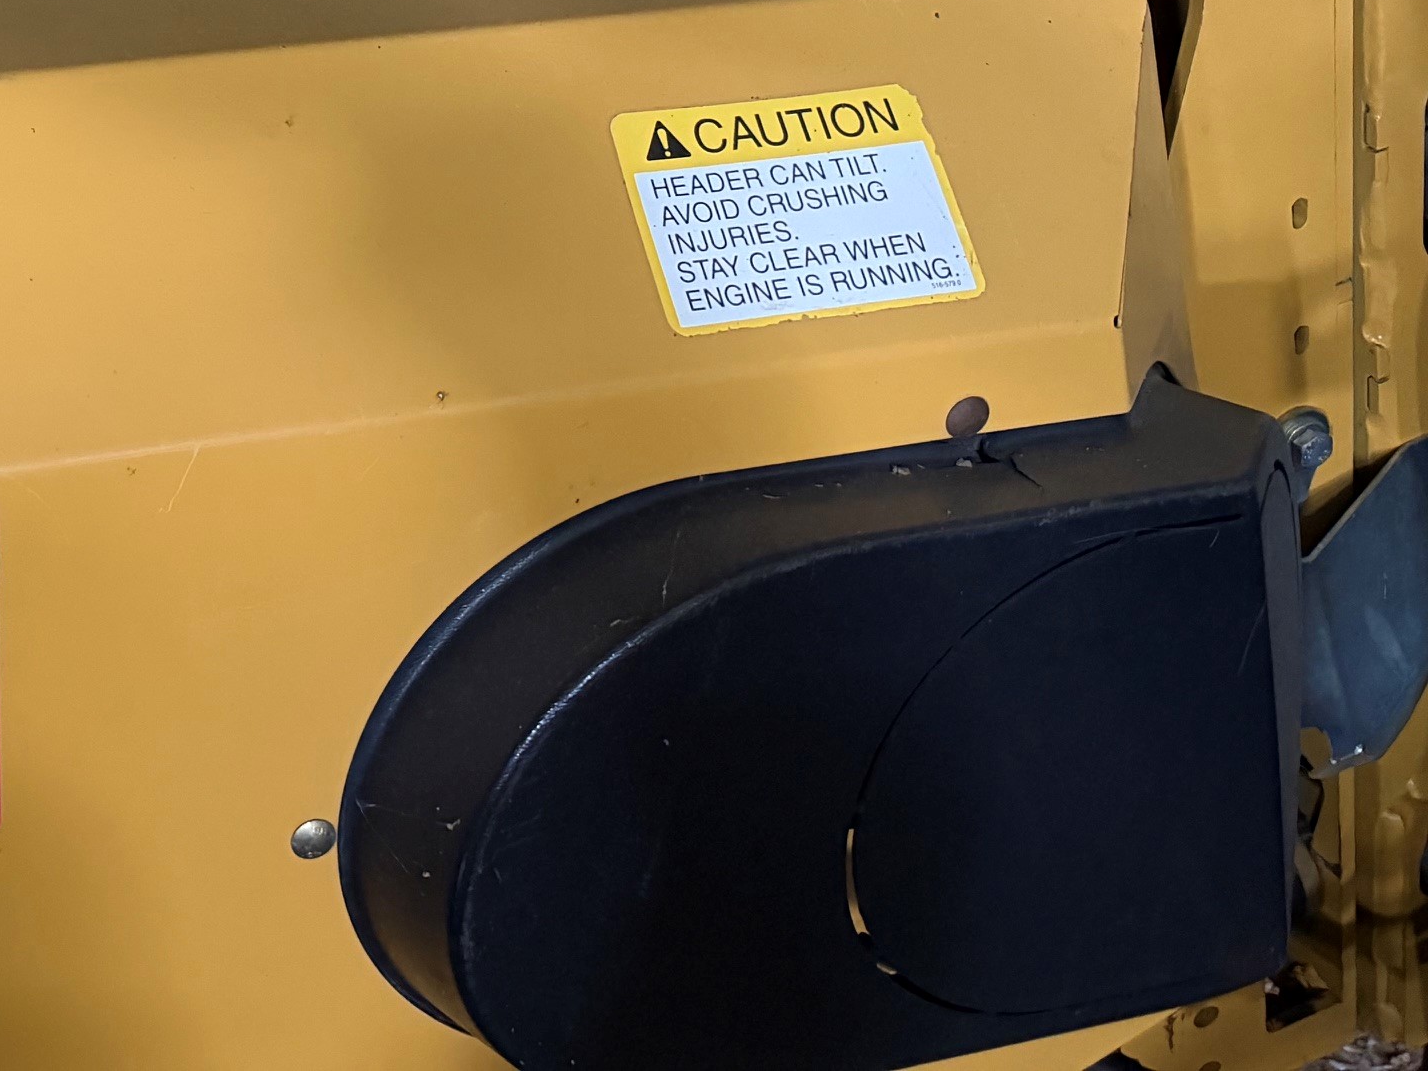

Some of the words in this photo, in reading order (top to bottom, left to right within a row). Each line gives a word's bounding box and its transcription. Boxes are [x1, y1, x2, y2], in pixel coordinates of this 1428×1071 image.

[694, 98, 899, 154] CAUTION
[651, 168, 763, 199] HEADER
[769, 160, 825, 186] CAN
[832, 154, 886, 177] TILT.
[662, 198, 739, 227] AVOID
[748, 181, 887, 215] CRUSHING
[668, 221, 798, 254] INJURIES.
[678, 255, 739, 283] STAY
[749, 243, 839, 274] CLEAR
[842, 232, 926, 262] WHEN
[686, 278, 791, 312] ENGINE
[797, 273, 823, 296] IS
[830, 257, 959, 293] RUNNING.
